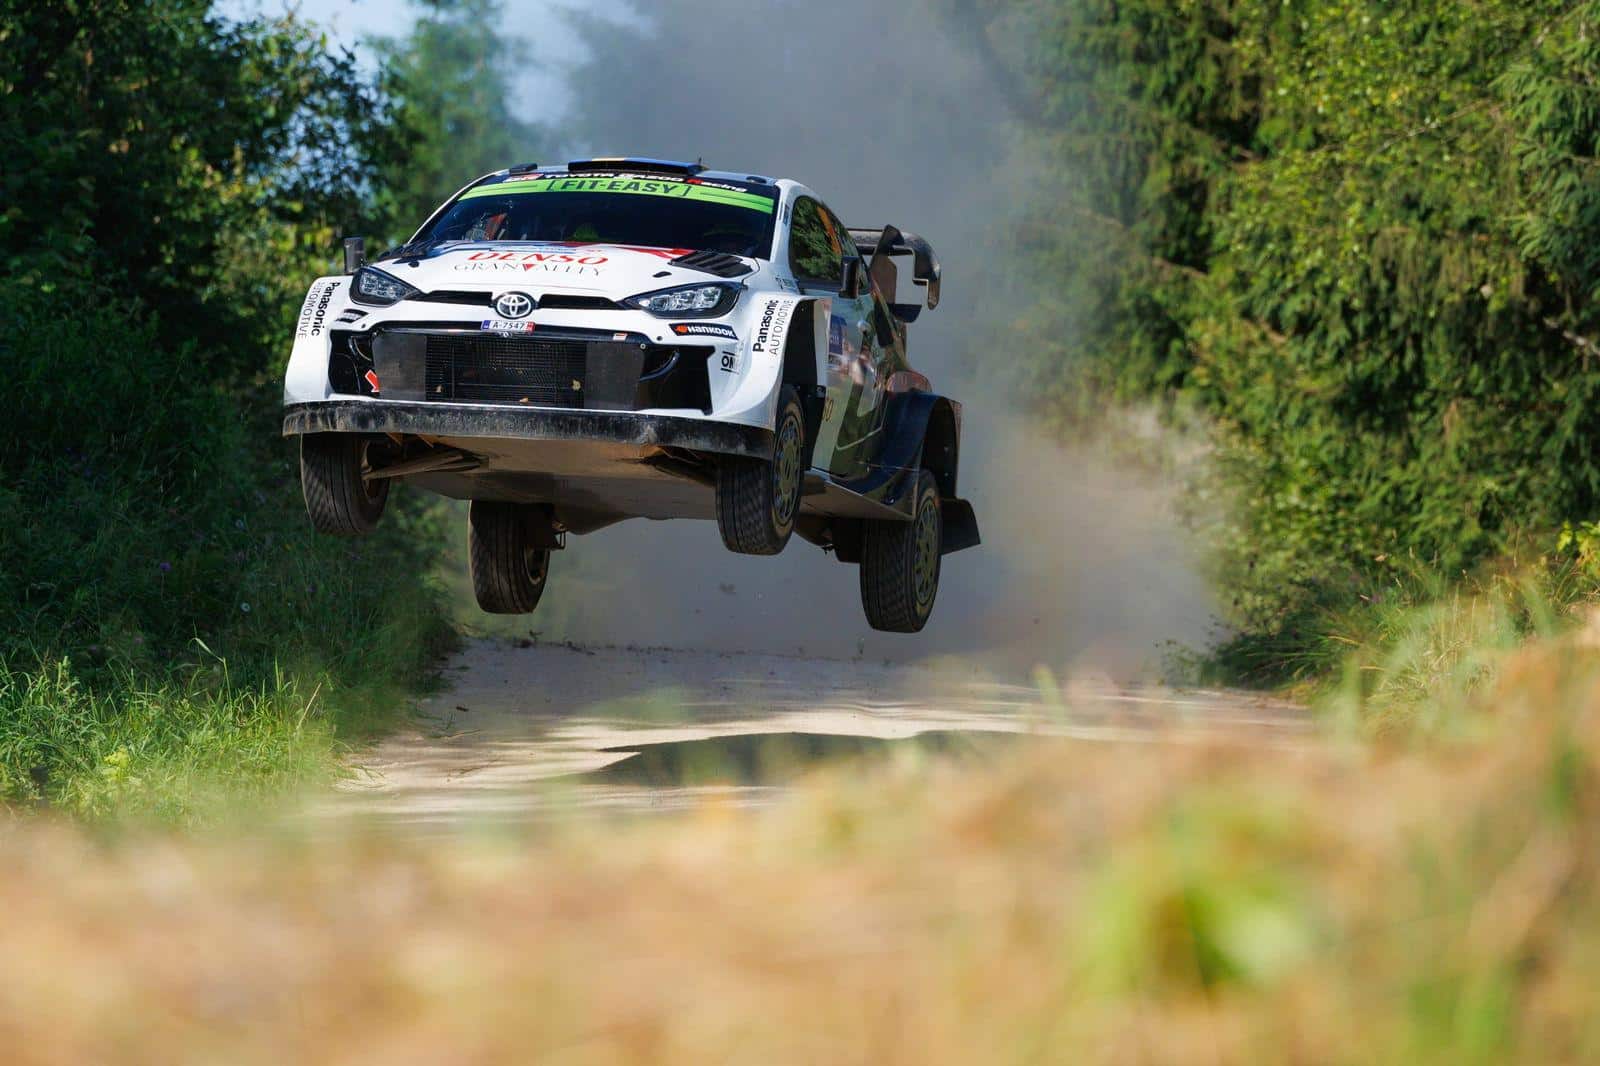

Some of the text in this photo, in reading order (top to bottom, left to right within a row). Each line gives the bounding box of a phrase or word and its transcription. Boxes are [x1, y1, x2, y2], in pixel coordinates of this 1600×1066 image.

[467, 251, 609, 265] DENSO
[311, 281, 341, 337] Panasonic
[752, 300, 779, 353] Panasonic
